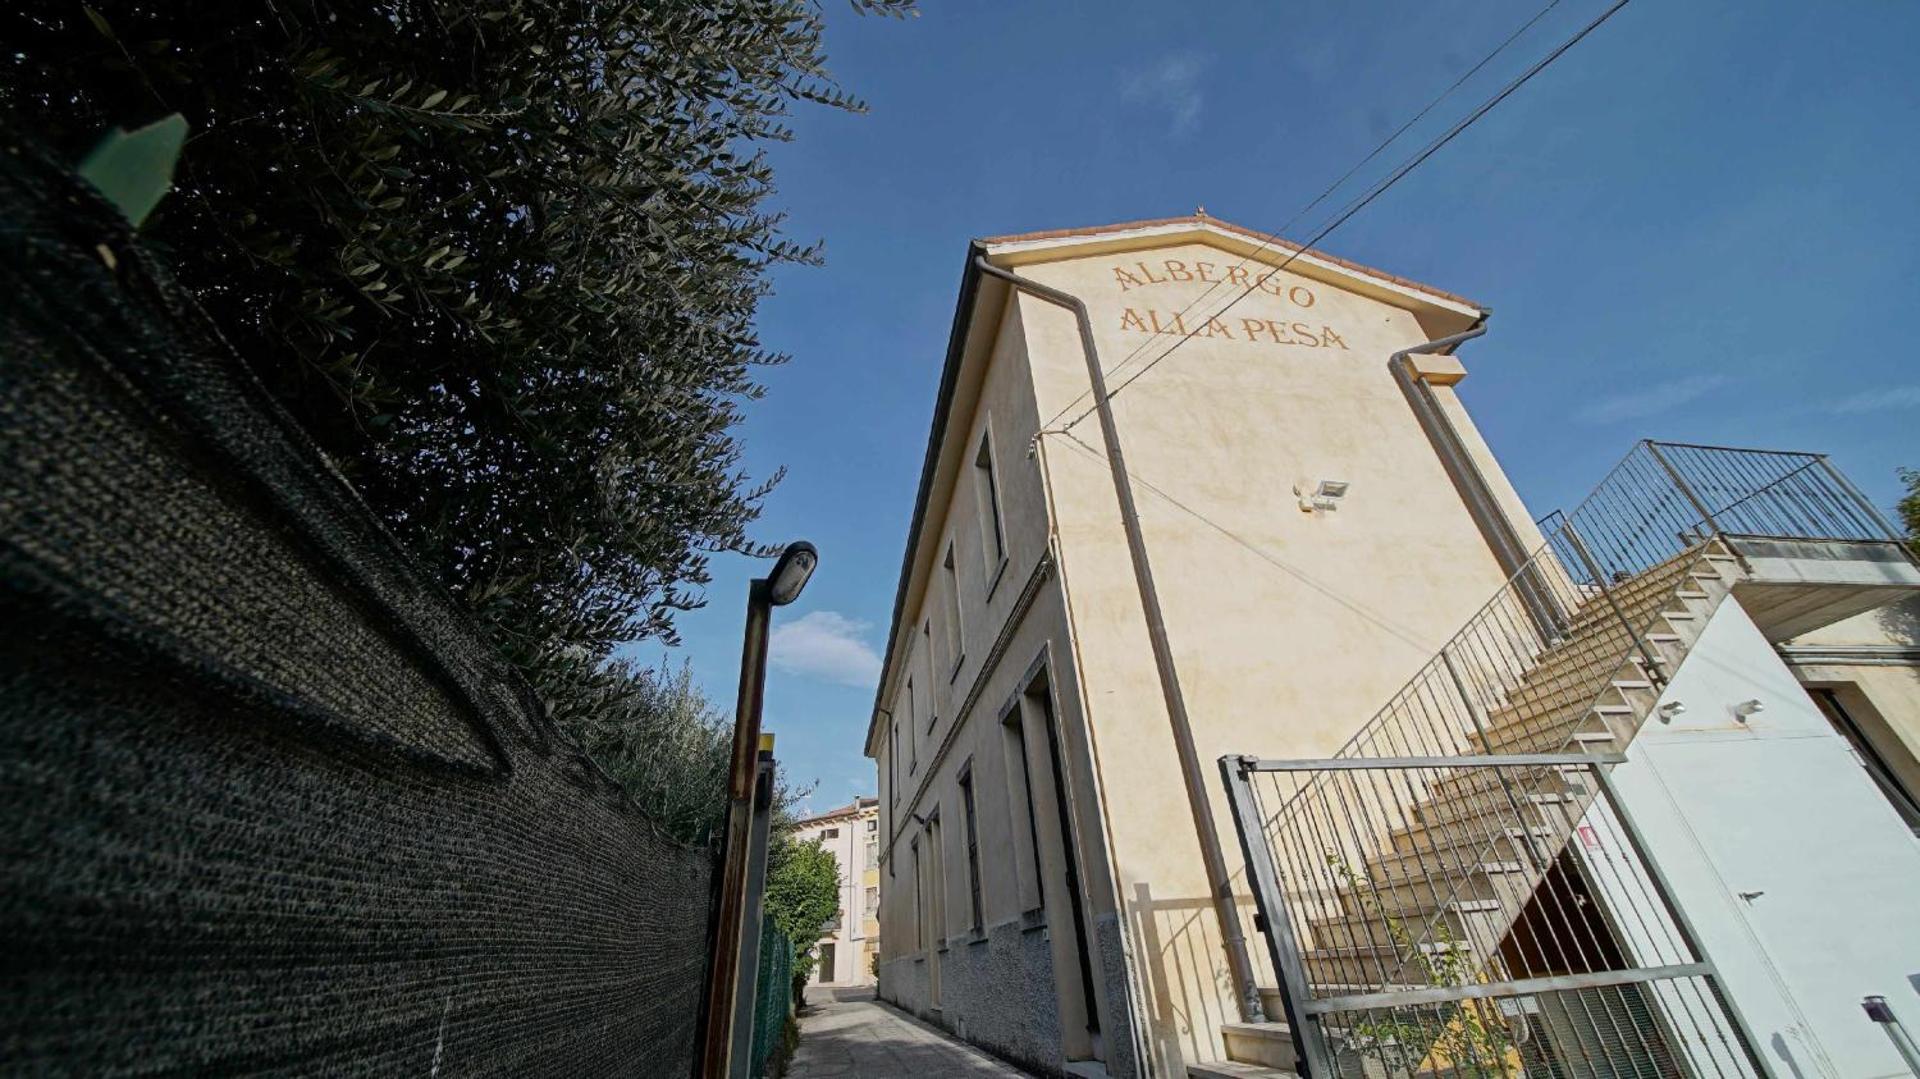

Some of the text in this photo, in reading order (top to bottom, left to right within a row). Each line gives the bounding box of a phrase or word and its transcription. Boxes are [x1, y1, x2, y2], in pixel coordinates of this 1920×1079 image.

[1112, 260, 1315, 308] ALBERGO
[1120, 308, 1350, 350] ALLA PESA
